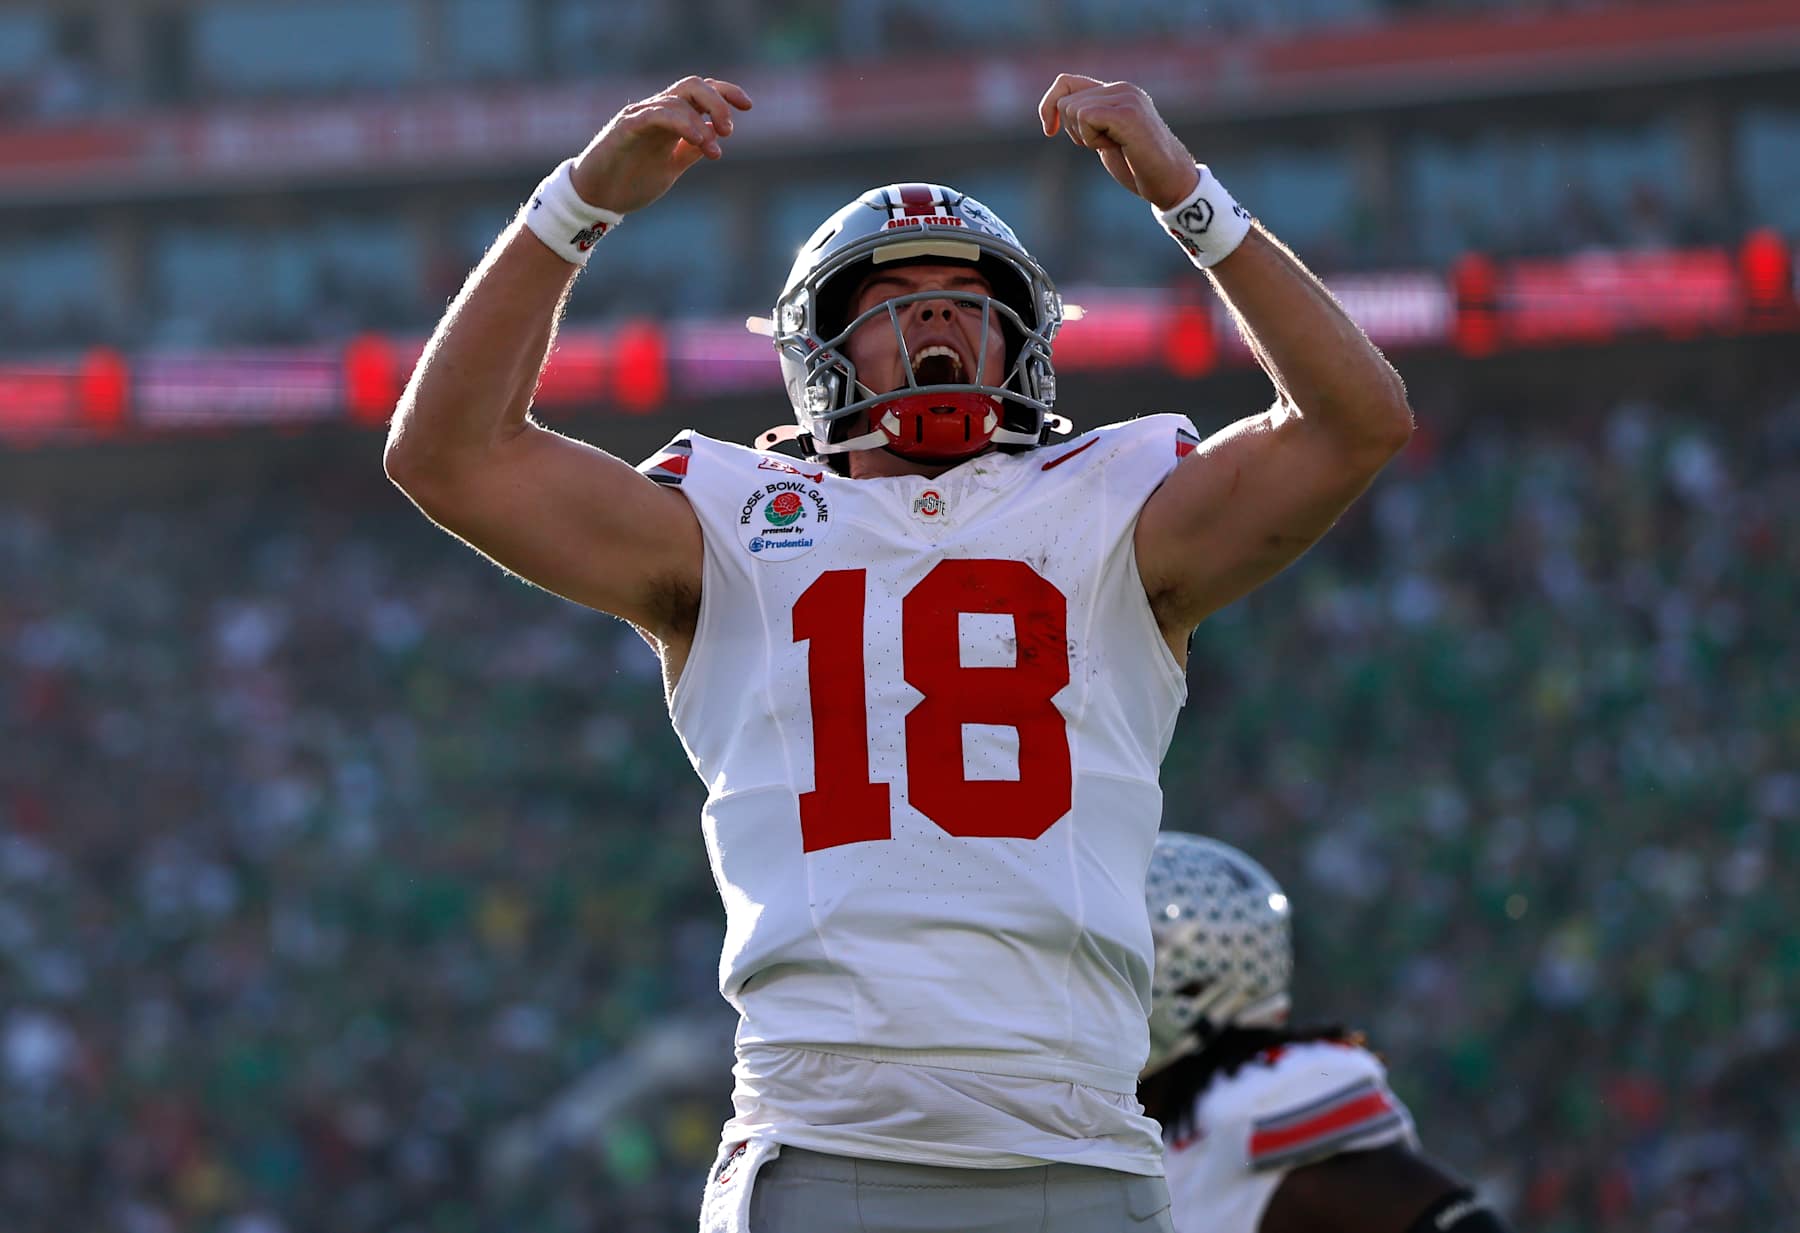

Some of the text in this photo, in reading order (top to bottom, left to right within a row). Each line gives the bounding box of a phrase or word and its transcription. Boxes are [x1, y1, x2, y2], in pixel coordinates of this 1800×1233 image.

[740, 481, 828, 524] ROSE BOWL GAME
[761, 526, 804, 536] presented by
[765, 538, 813, 549] Prudential
[792, 558, 1072, 854] 18
